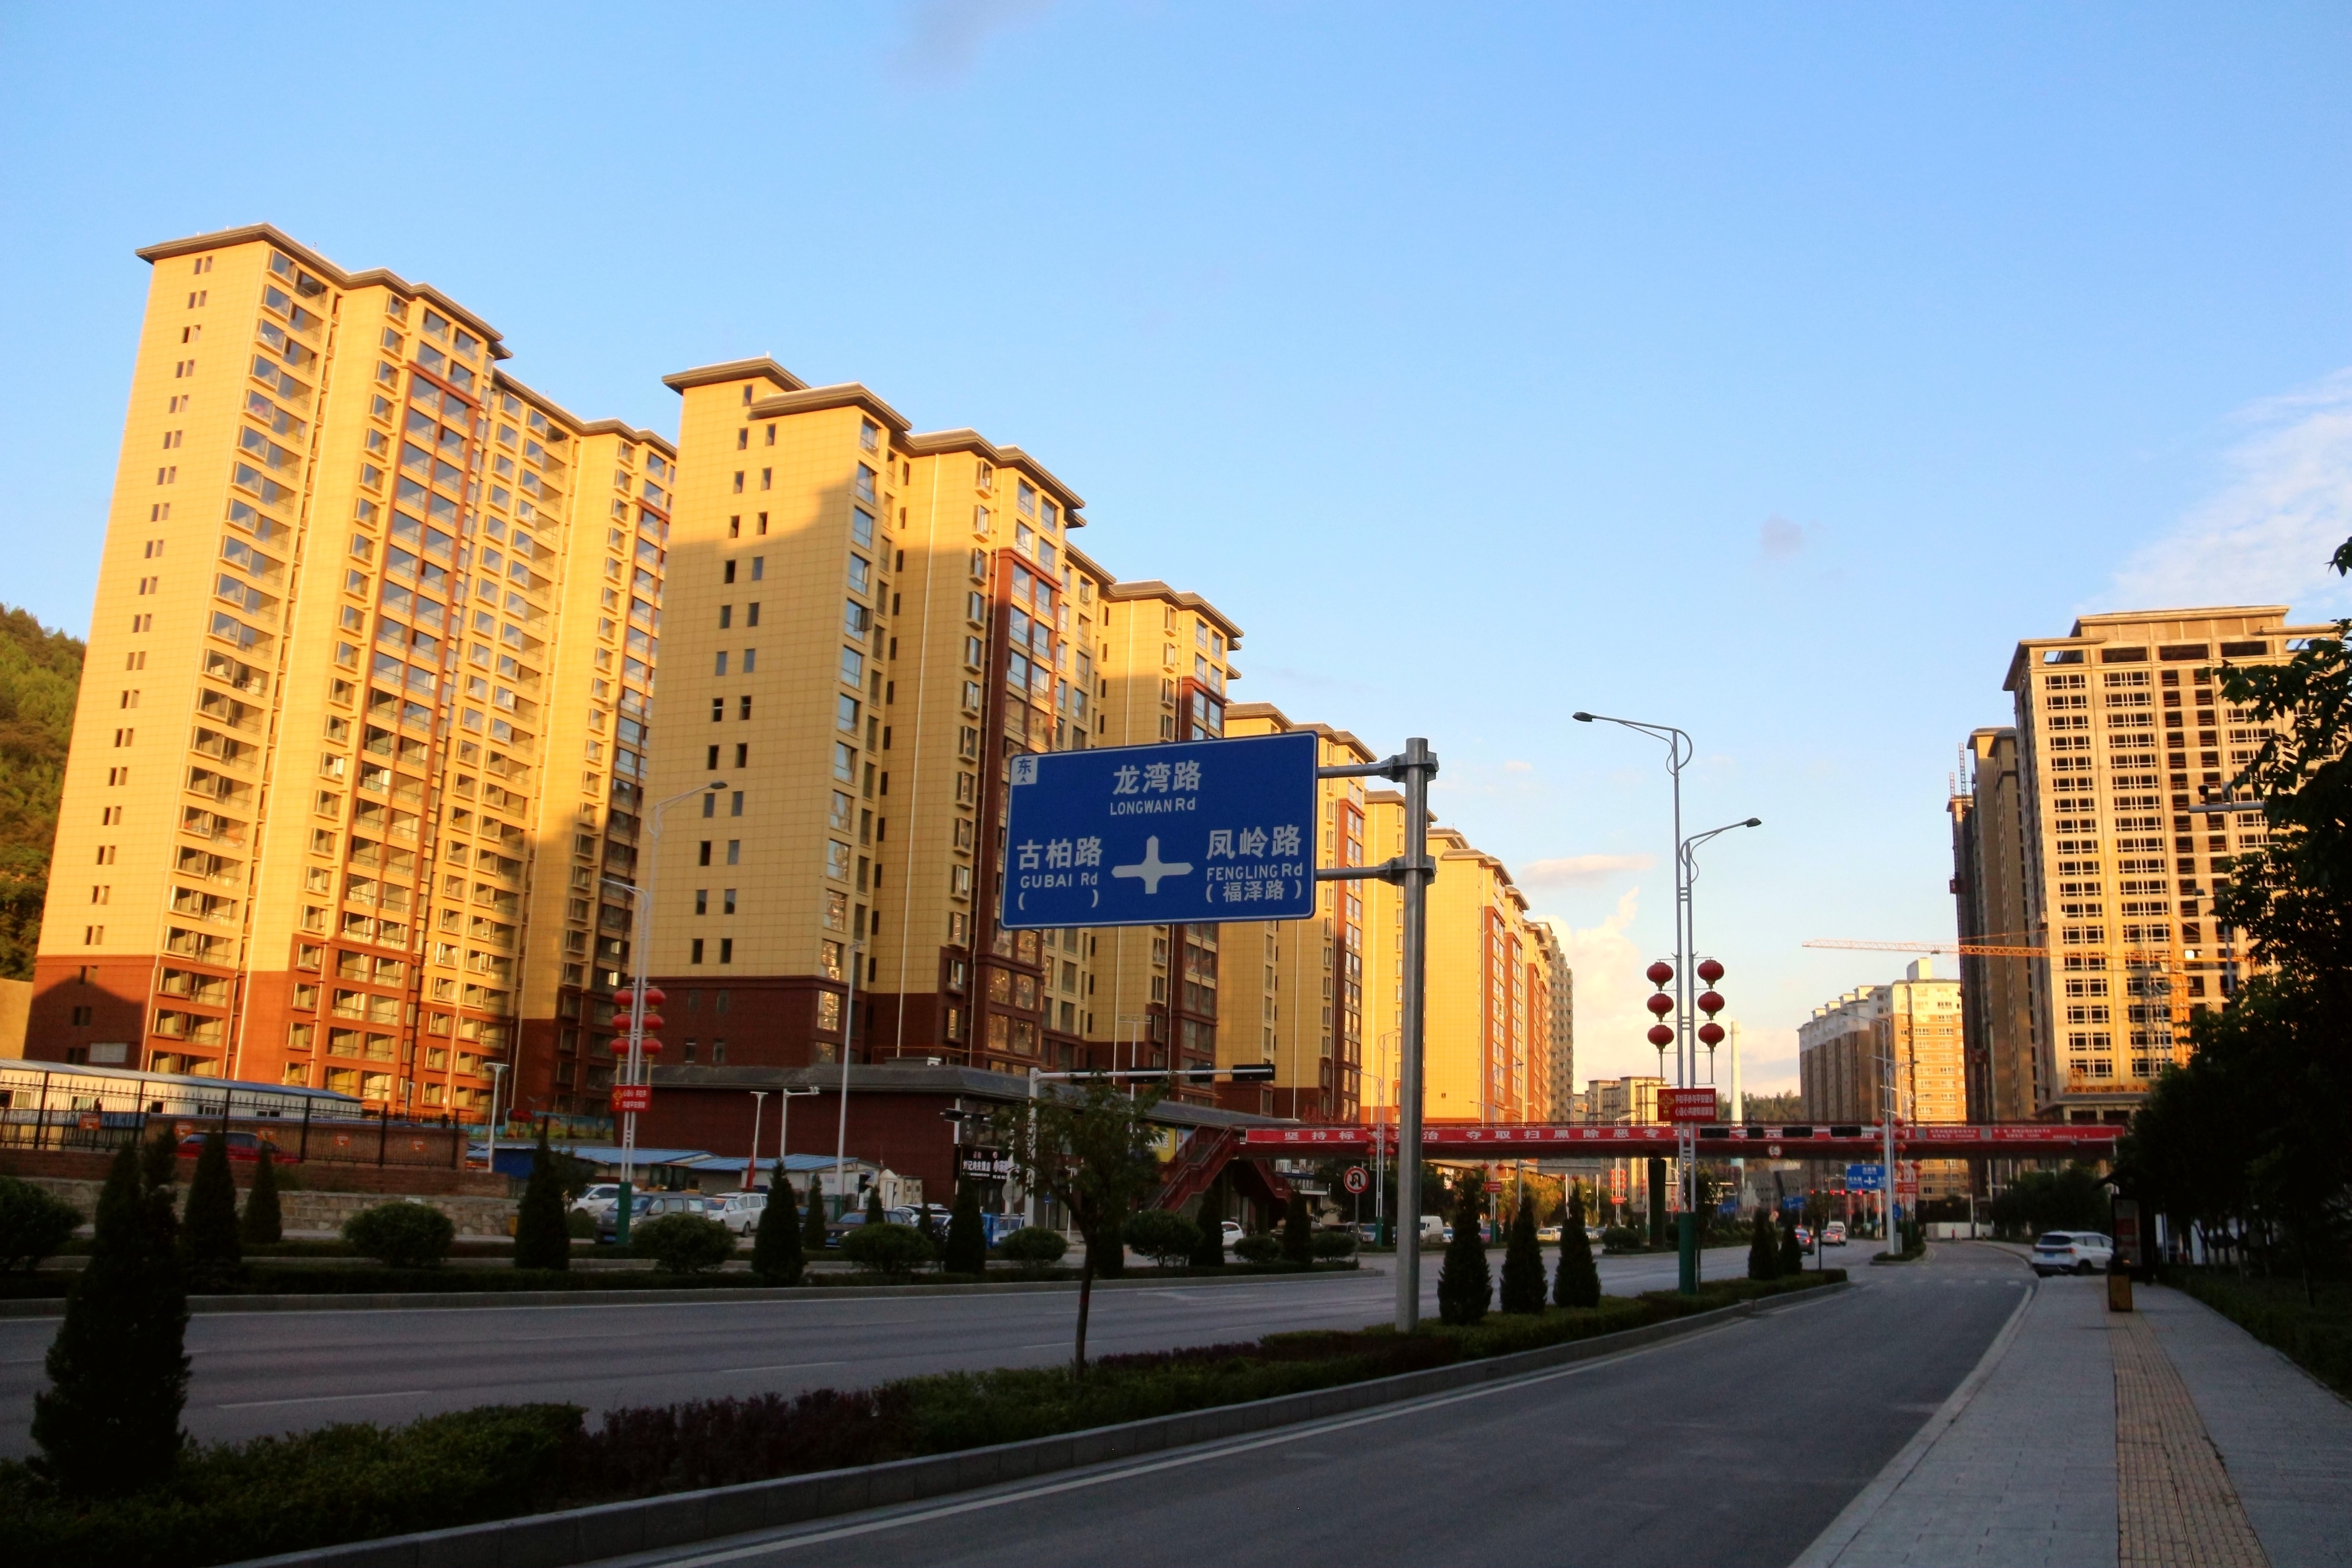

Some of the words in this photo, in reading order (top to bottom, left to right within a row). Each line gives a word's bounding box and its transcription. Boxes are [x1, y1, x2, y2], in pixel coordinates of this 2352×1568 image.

[1018, 758, 1031, 774] 东
[1112, 760, 1201, 795] 龙湾路
[1110, 799, 1172, 815] LONGWAN
[1175, 797, 1196, 811] Rd
[1206, 824, 1301, 860] 凤岭路
[1017, 836, 1102, 870] 古柏路
[1021, 873, 1072, 888] GUBAI
[1081, 872, 1098, 886] Rd
[1207, 864, 1278, 881] FENGLING
[1282, 862, 1303, 877] Rd
